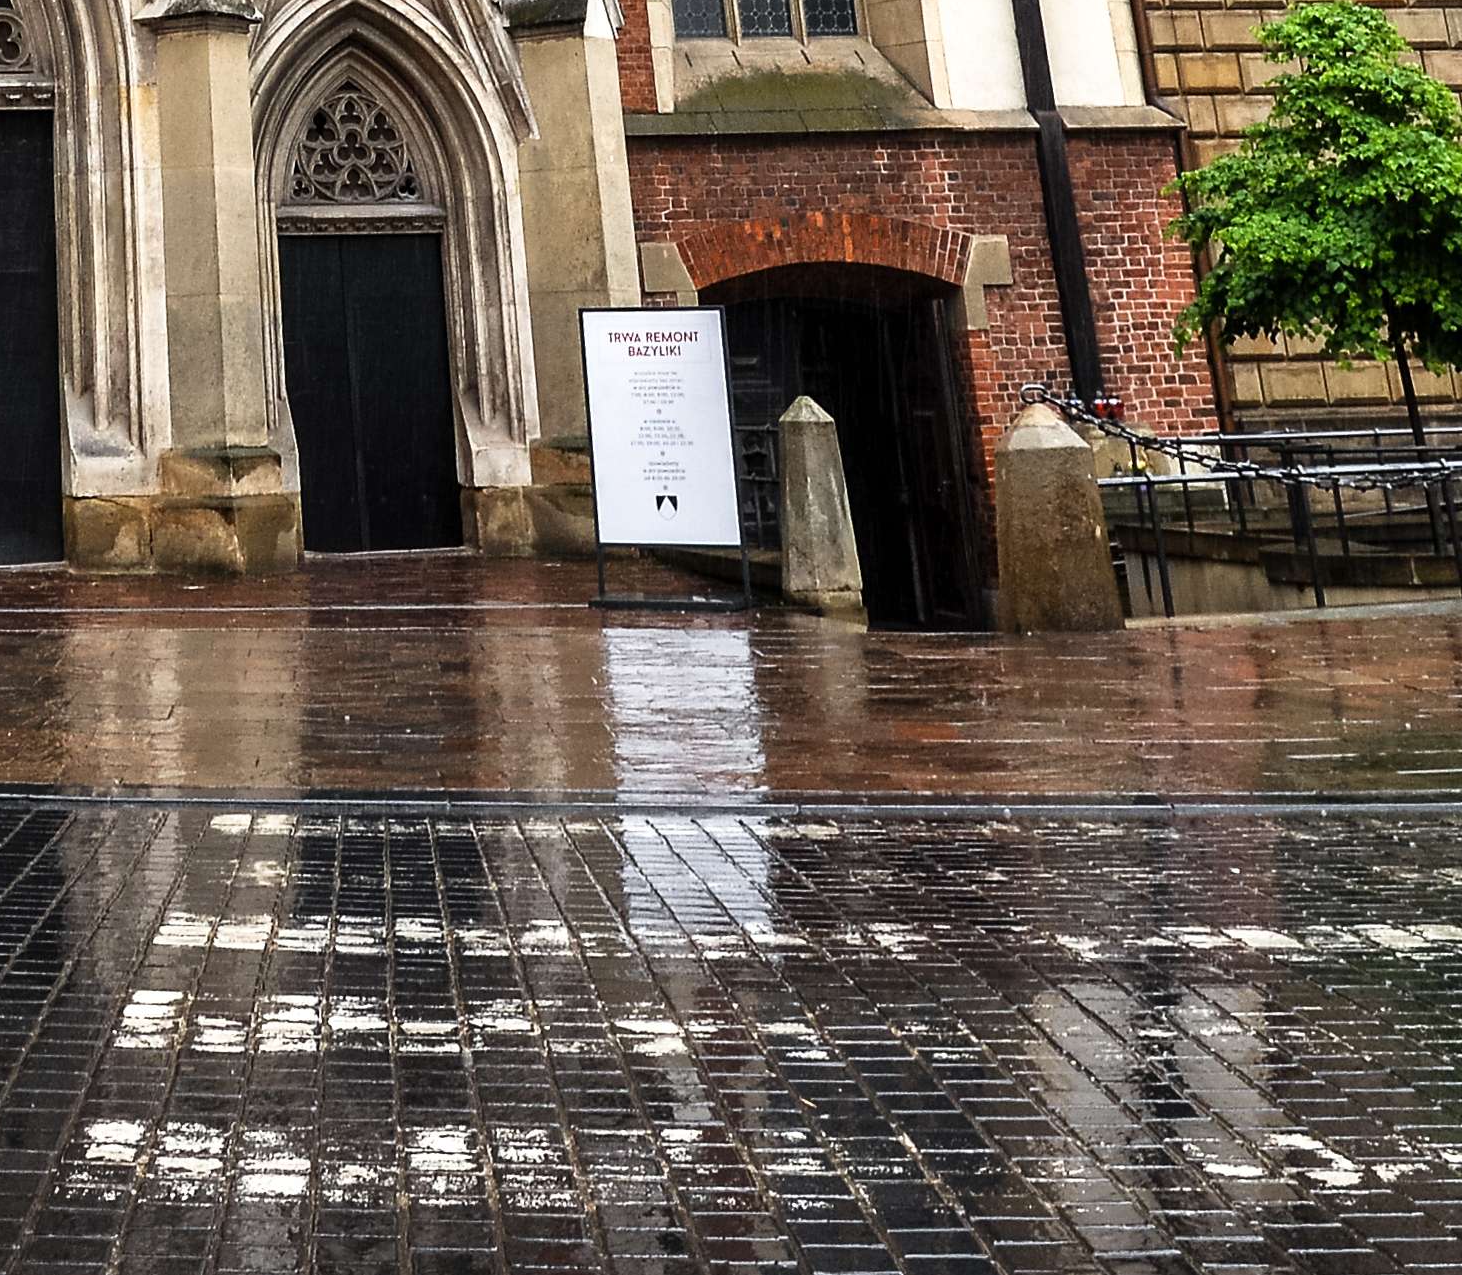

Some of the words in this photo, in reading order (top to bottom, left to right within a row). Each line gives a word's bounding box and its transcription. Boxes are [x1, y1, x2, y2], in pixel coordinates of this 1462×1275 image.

[608, 332, 641, 343] TRWA
[645, 331, 699, 343] REMONT
[628, 345, 682, 357] BAZYLIKI
